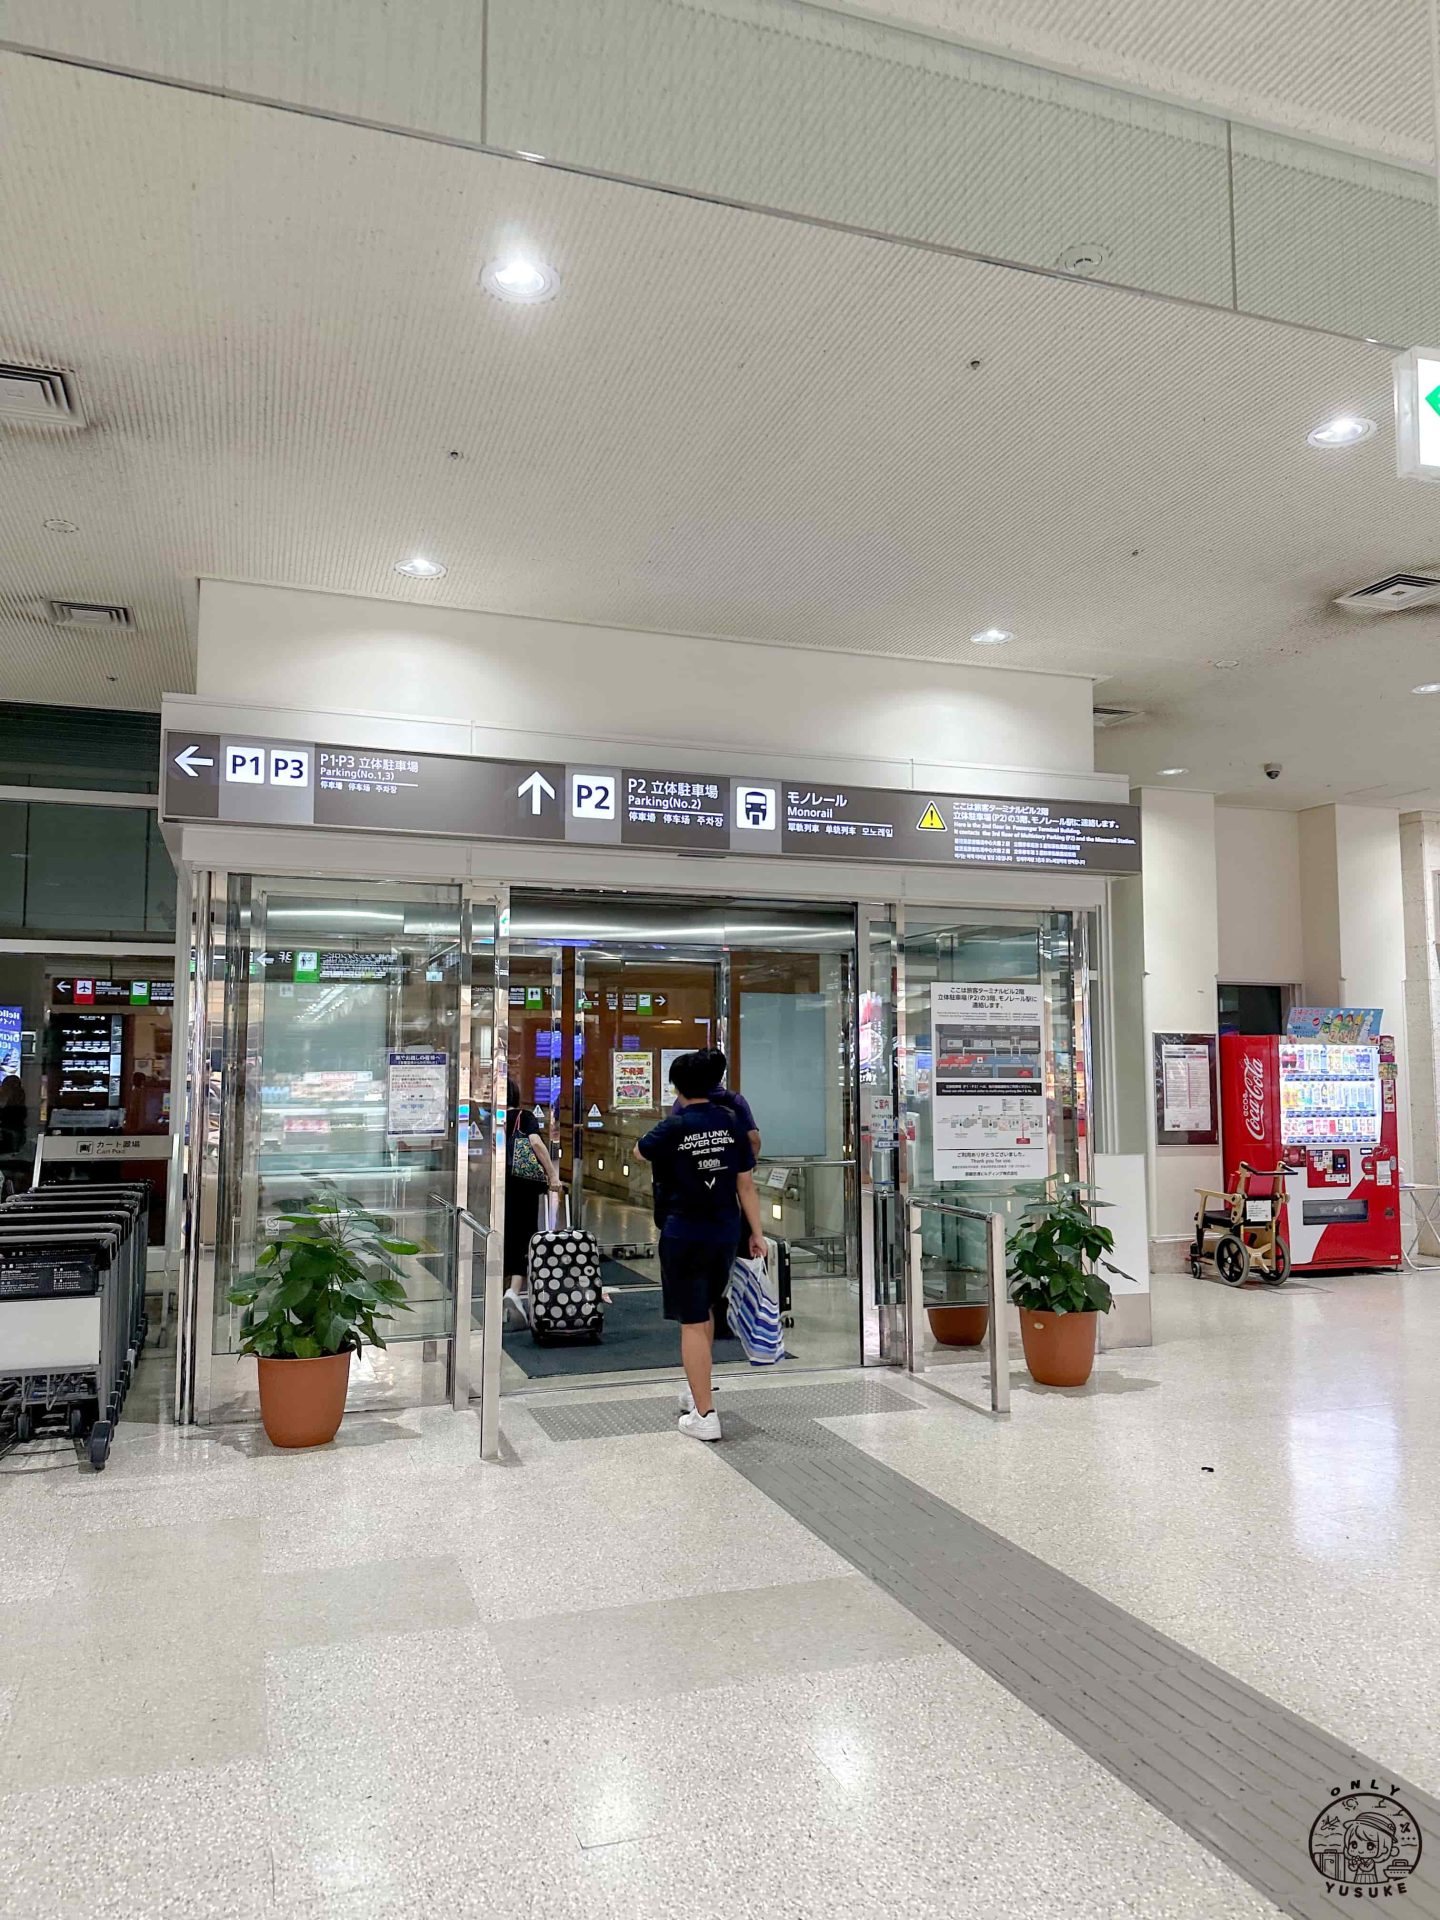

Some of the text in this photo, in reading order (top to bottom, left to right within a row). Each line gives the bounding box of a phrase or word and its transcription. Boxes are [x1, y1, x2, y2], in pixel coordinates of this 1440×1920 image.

[232, 755, 260, 776] P1
[274, 758, 304, 779] P3
[358, 756, 418, 773] 立体駐車場
[320, 766, 394, 781] Parking(No.1,3)
[628, 778, 719, 799] P2 立体駐車場
[576, 785, 610, 810] P2
[628, 795, 702, 810] Parking(No.2)
[788, 792, 848, 808] モノレール
[628, 811, 690, 825] 停車場 停车场
[788, 806, 833, 818] Monorail
[696, 815, 723, 828] 주차장
[862, 826, 894, 838] 모노레일
[1243, 1052, 1265, 1141] Coca-Cola
[678, 1136, 734, 1150] ROVER CREW
[684, 1130, 730, 1142] MEIJI UNIV.
[698, 1158, 720, 1168] 100th
